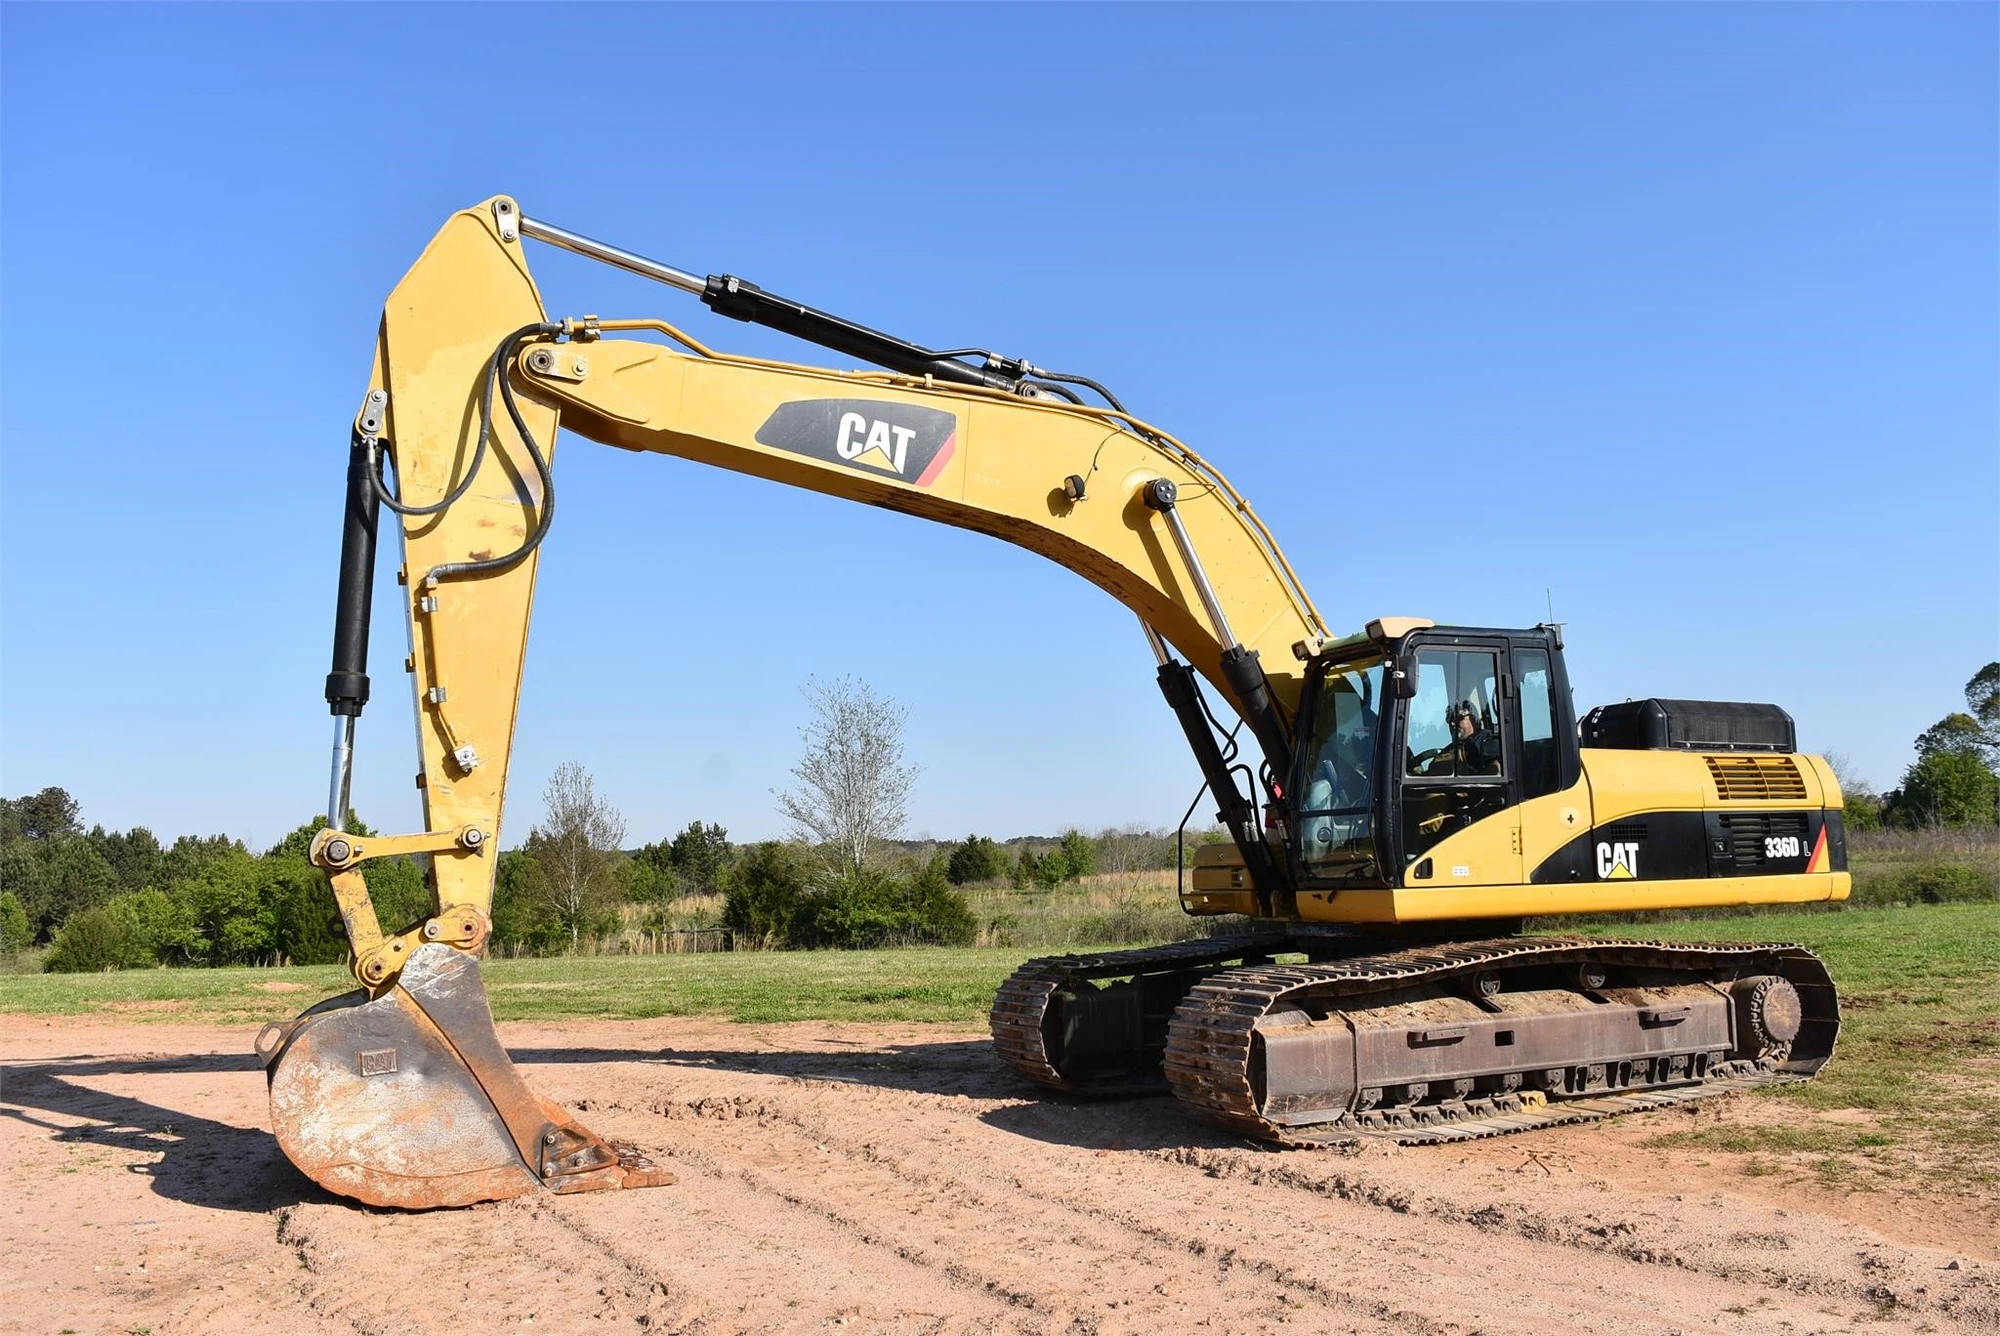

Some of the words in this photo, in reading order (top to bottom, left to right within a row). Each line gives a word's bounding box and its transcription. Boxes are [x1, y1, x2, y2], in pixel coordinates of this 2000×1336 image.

[836, 412, 916, 475] CAT
[1596, 841, 1639, 879] CAT
[1765, 836, 1799, 858] 336D
[1803, 840, 1811, 856] L
